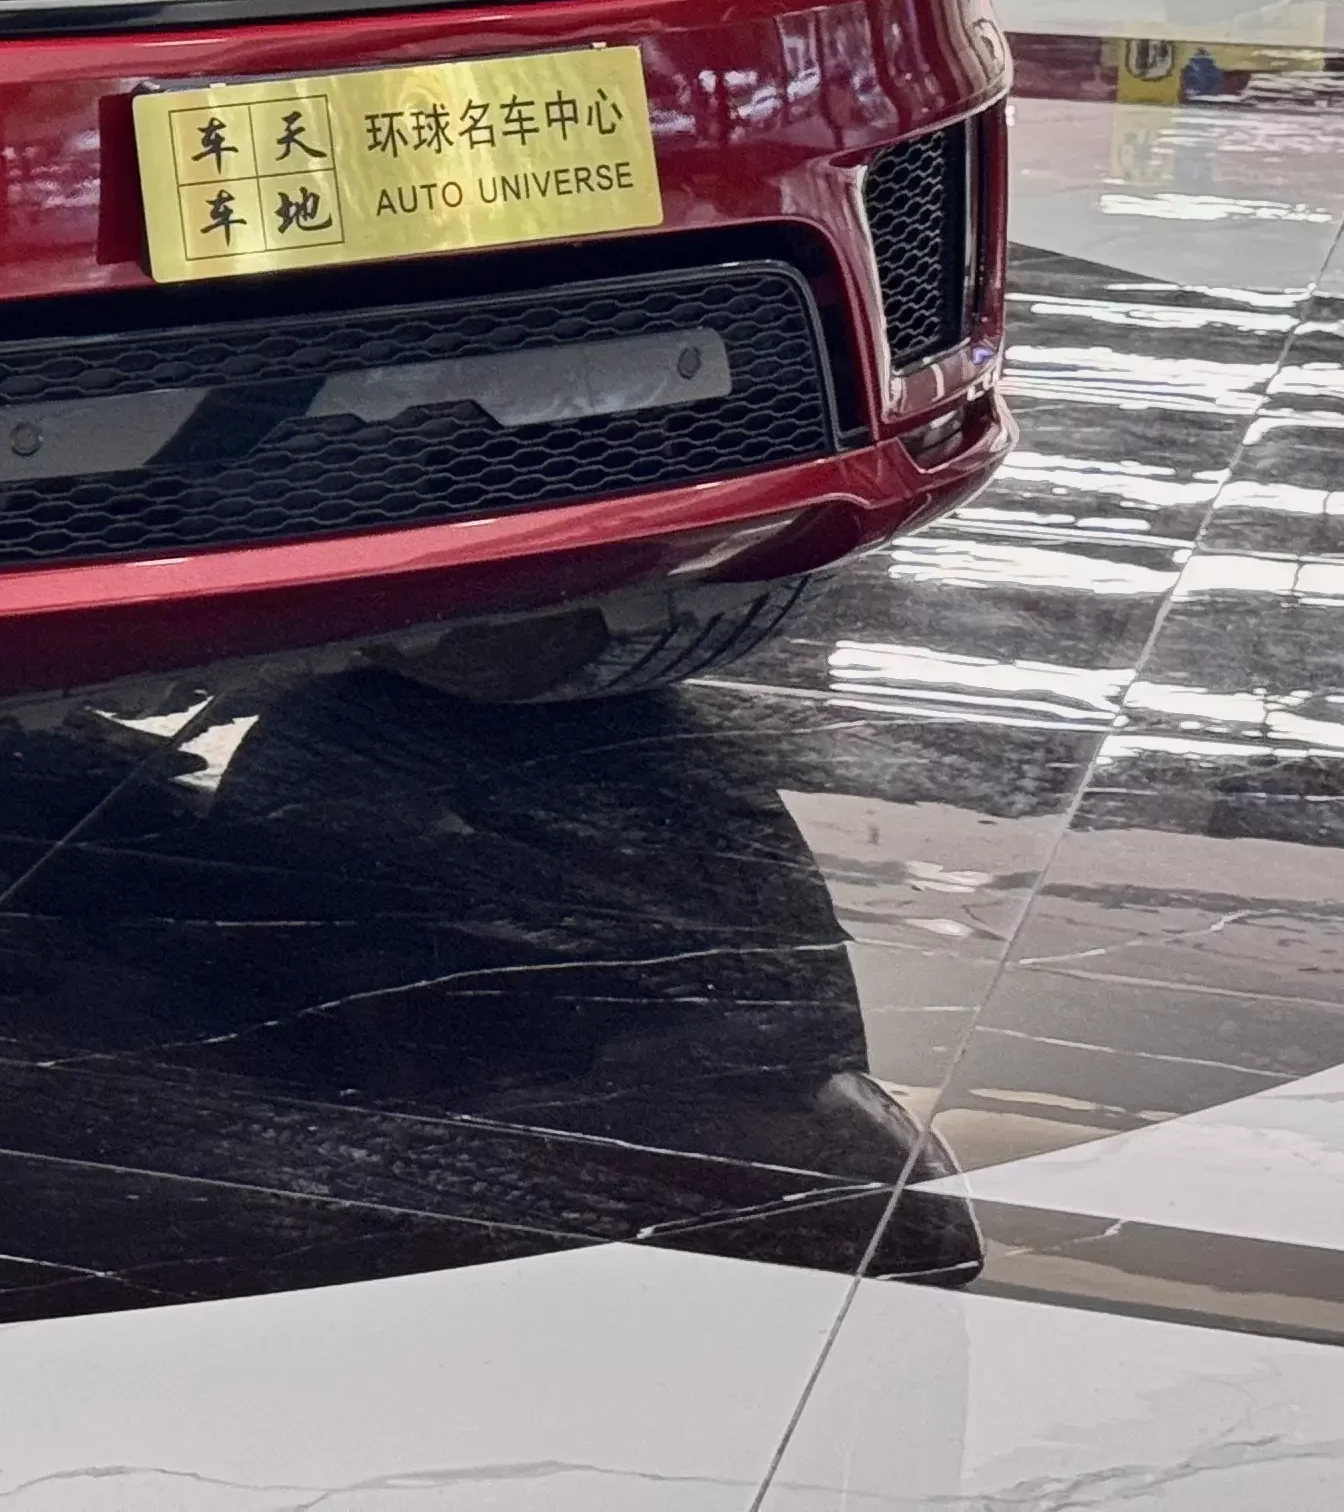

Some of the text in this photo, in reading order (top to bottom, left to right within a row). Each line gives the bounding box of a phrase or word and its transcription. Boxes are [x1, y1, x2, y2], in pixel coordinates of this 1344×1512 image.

[364, 87, 624, 159] 环球名车中心
[375, 161, 635, 217] AUTO UNIVERSE
